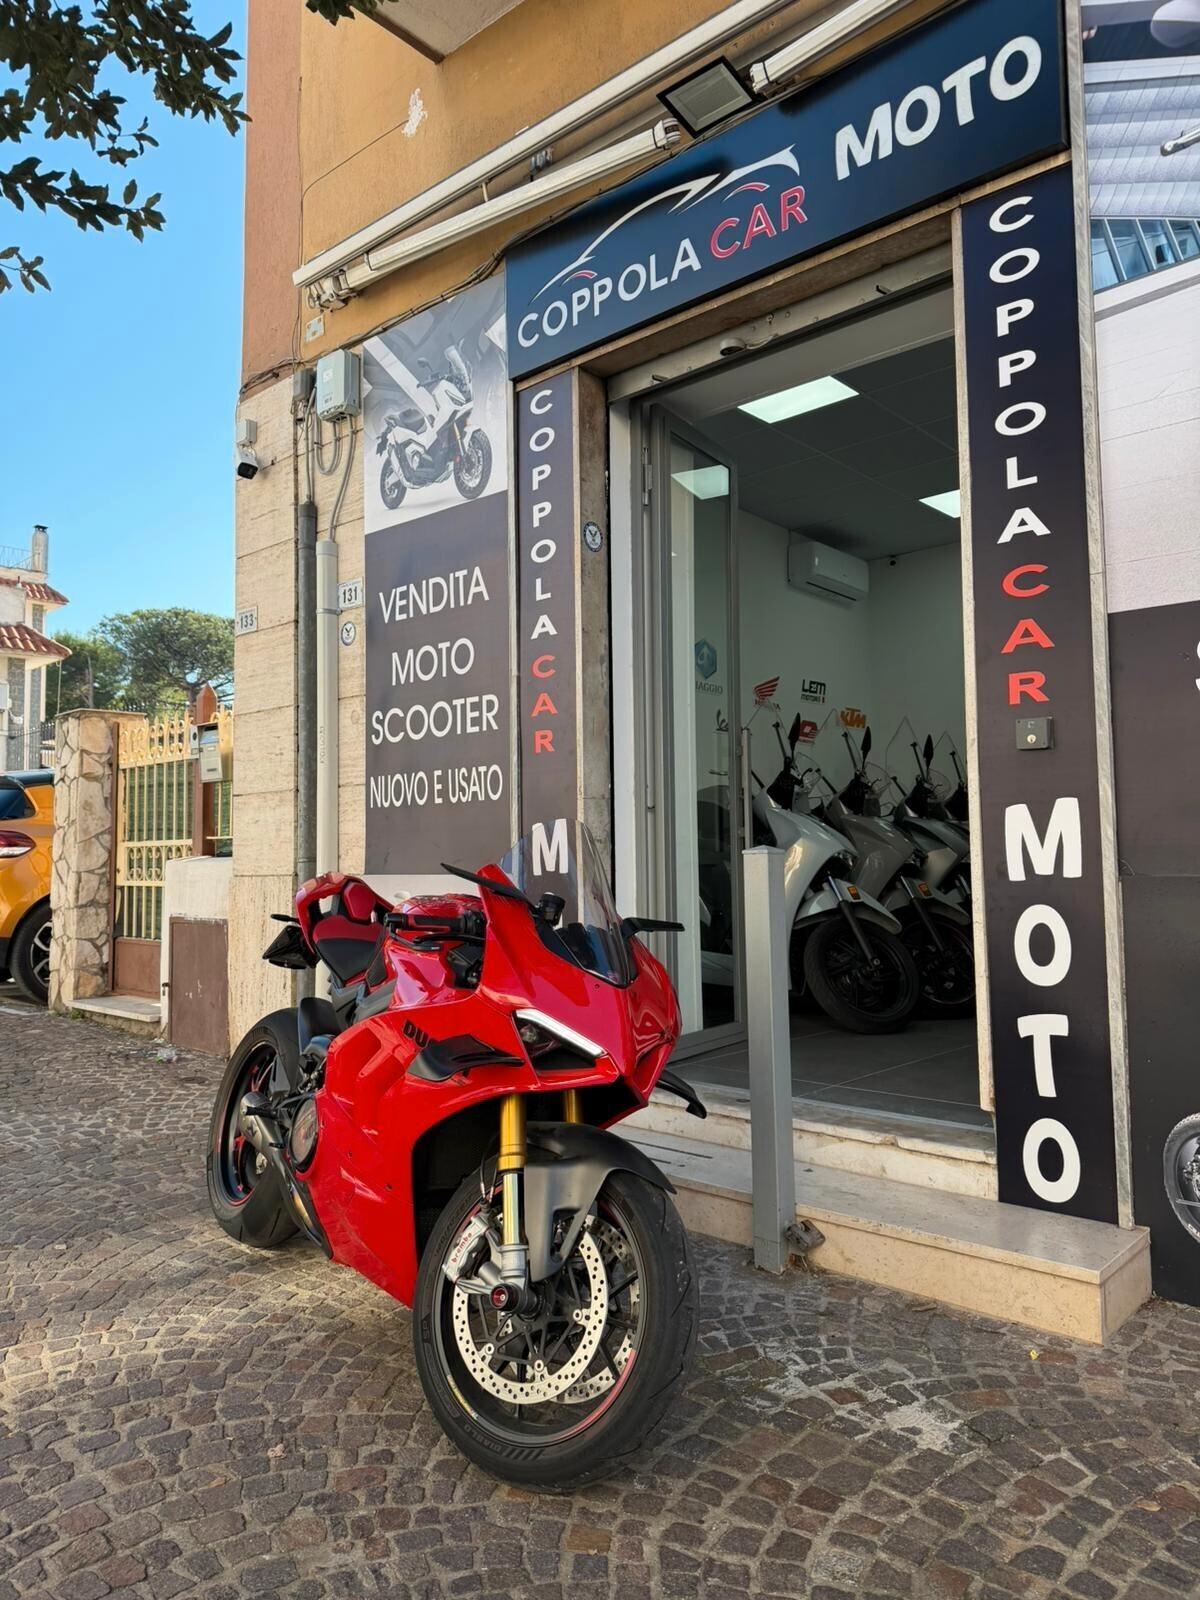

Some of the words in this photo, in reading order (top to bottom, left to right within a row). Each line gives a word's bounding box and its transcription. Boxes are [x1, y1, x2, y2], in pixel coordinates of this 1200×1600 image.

[834, 35, 1042, 182] MOTO
[516, 236, 702, 350] COPPOLA
[709, 184, 808, 260] CAR
[988, 195, 1052, 545] COPPOLA
[528, 389, 559, 640] COPPOLA
[239, 613, 254, 629] 133
[342, 586, 358, 604] 131
[378, 566, 490, 624] VENDITA
[391, 637, 475, 687] MOTO
[1000, 563, 1056, 706] CAR
[530, 653, 559, 754] CAR
[695, 680, 724, 696] IAGGIO
[371, 693, 500, 746] SCOOTER
[369, 770, 429, 809] NUOVO
[433, 769, 443, 804] E
[447, 764, 503, 804] USATO
[1004, 796, 1083, 1203] MOTO
[402, 1019, 431, 1049] DU
[451, 1232, 473, 1263] brembo
